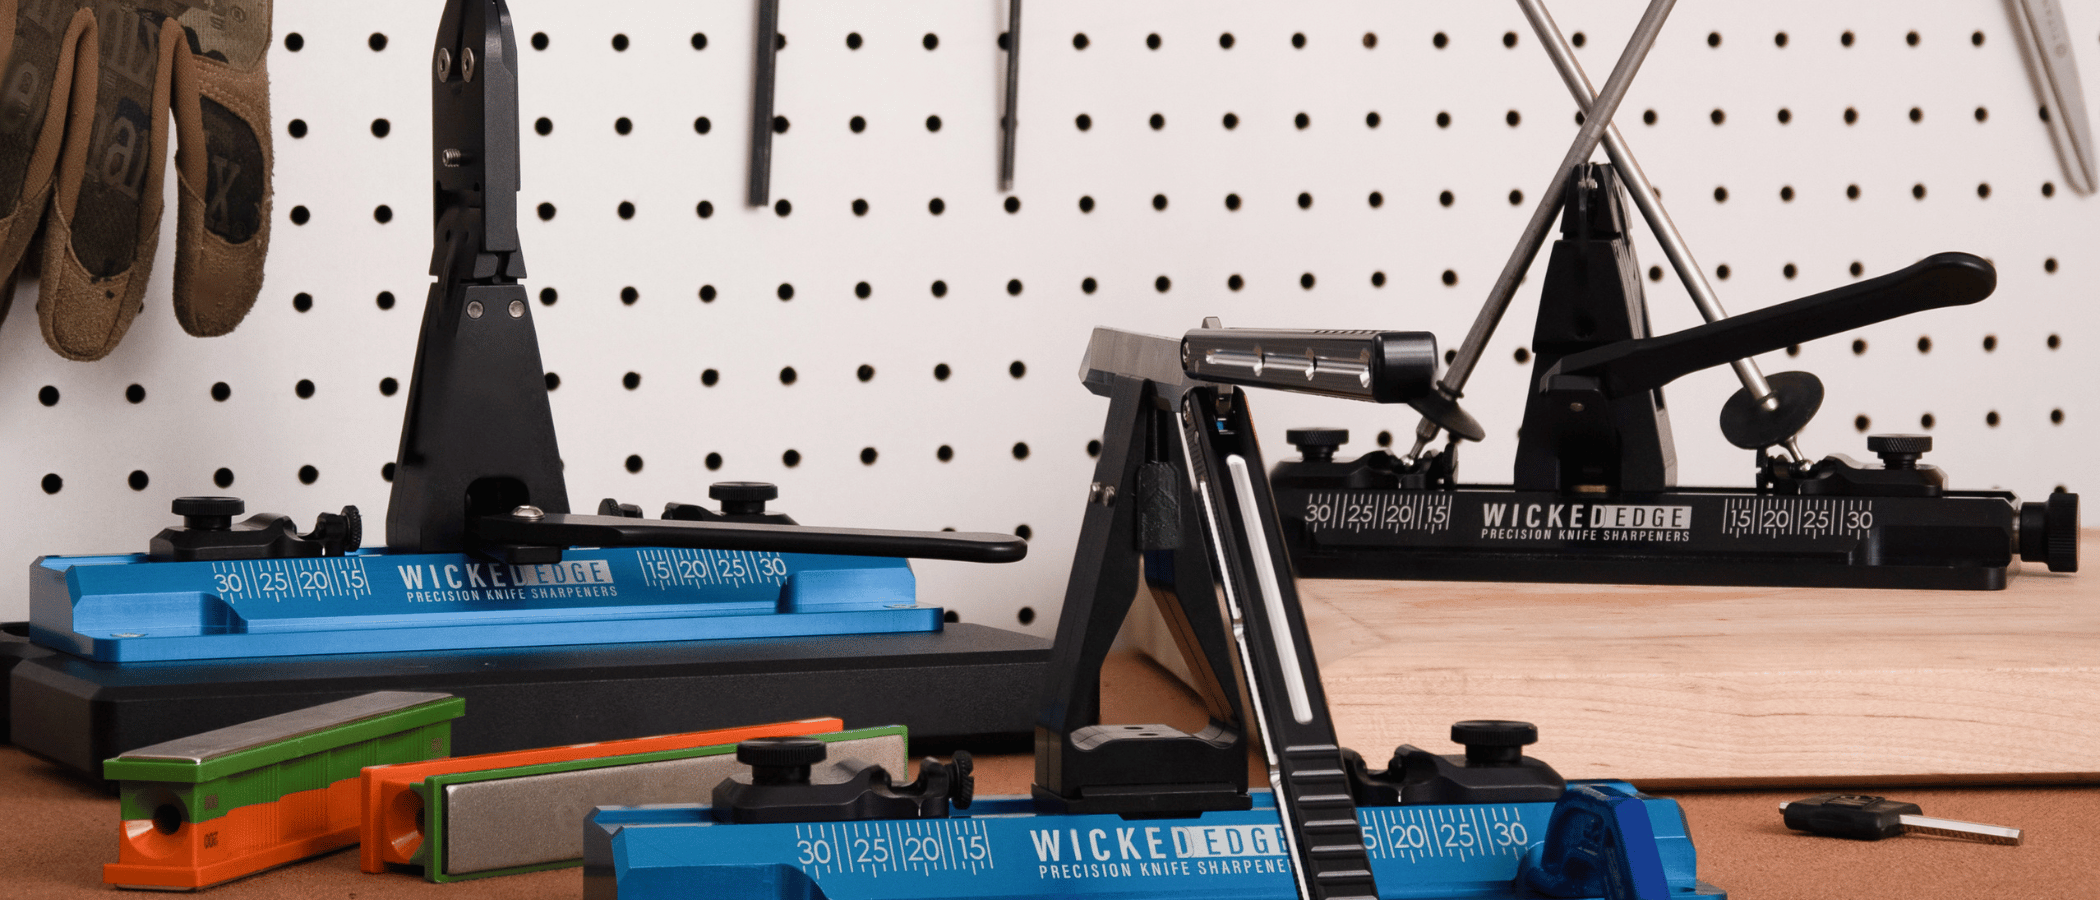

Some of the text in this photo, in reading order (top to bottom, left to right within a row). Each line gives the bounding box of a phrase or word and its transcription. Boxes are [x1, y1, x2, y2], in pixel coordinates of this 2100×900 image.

[1305, 504, 1447, 524] 30 25 20 15
[1482, 503, 1684, 529] WICKED EDGE
[1731, 510, 1873, 529] 15 20 25 30
[1481, 528, 1690, 542] PRECISION KNIFE SHARPENERS
[397, 561, 607, 590] WICKED EDGE
[646, 557, 787, 580] 15 20 25 30
[214, 569, 365, 593] 30 25 20 15
[406, 585, 618, 603] PRECISION KNIFE SHARPENERS
[1030, 827, 1194, 862] WICKED
[1362, 822, 1528, 850] 5 20 25 30
[797, 835, 986, 865] 30 25 20 15
[1039, 857, 1292, 879] PRECISION KNIFE SHARPENE
